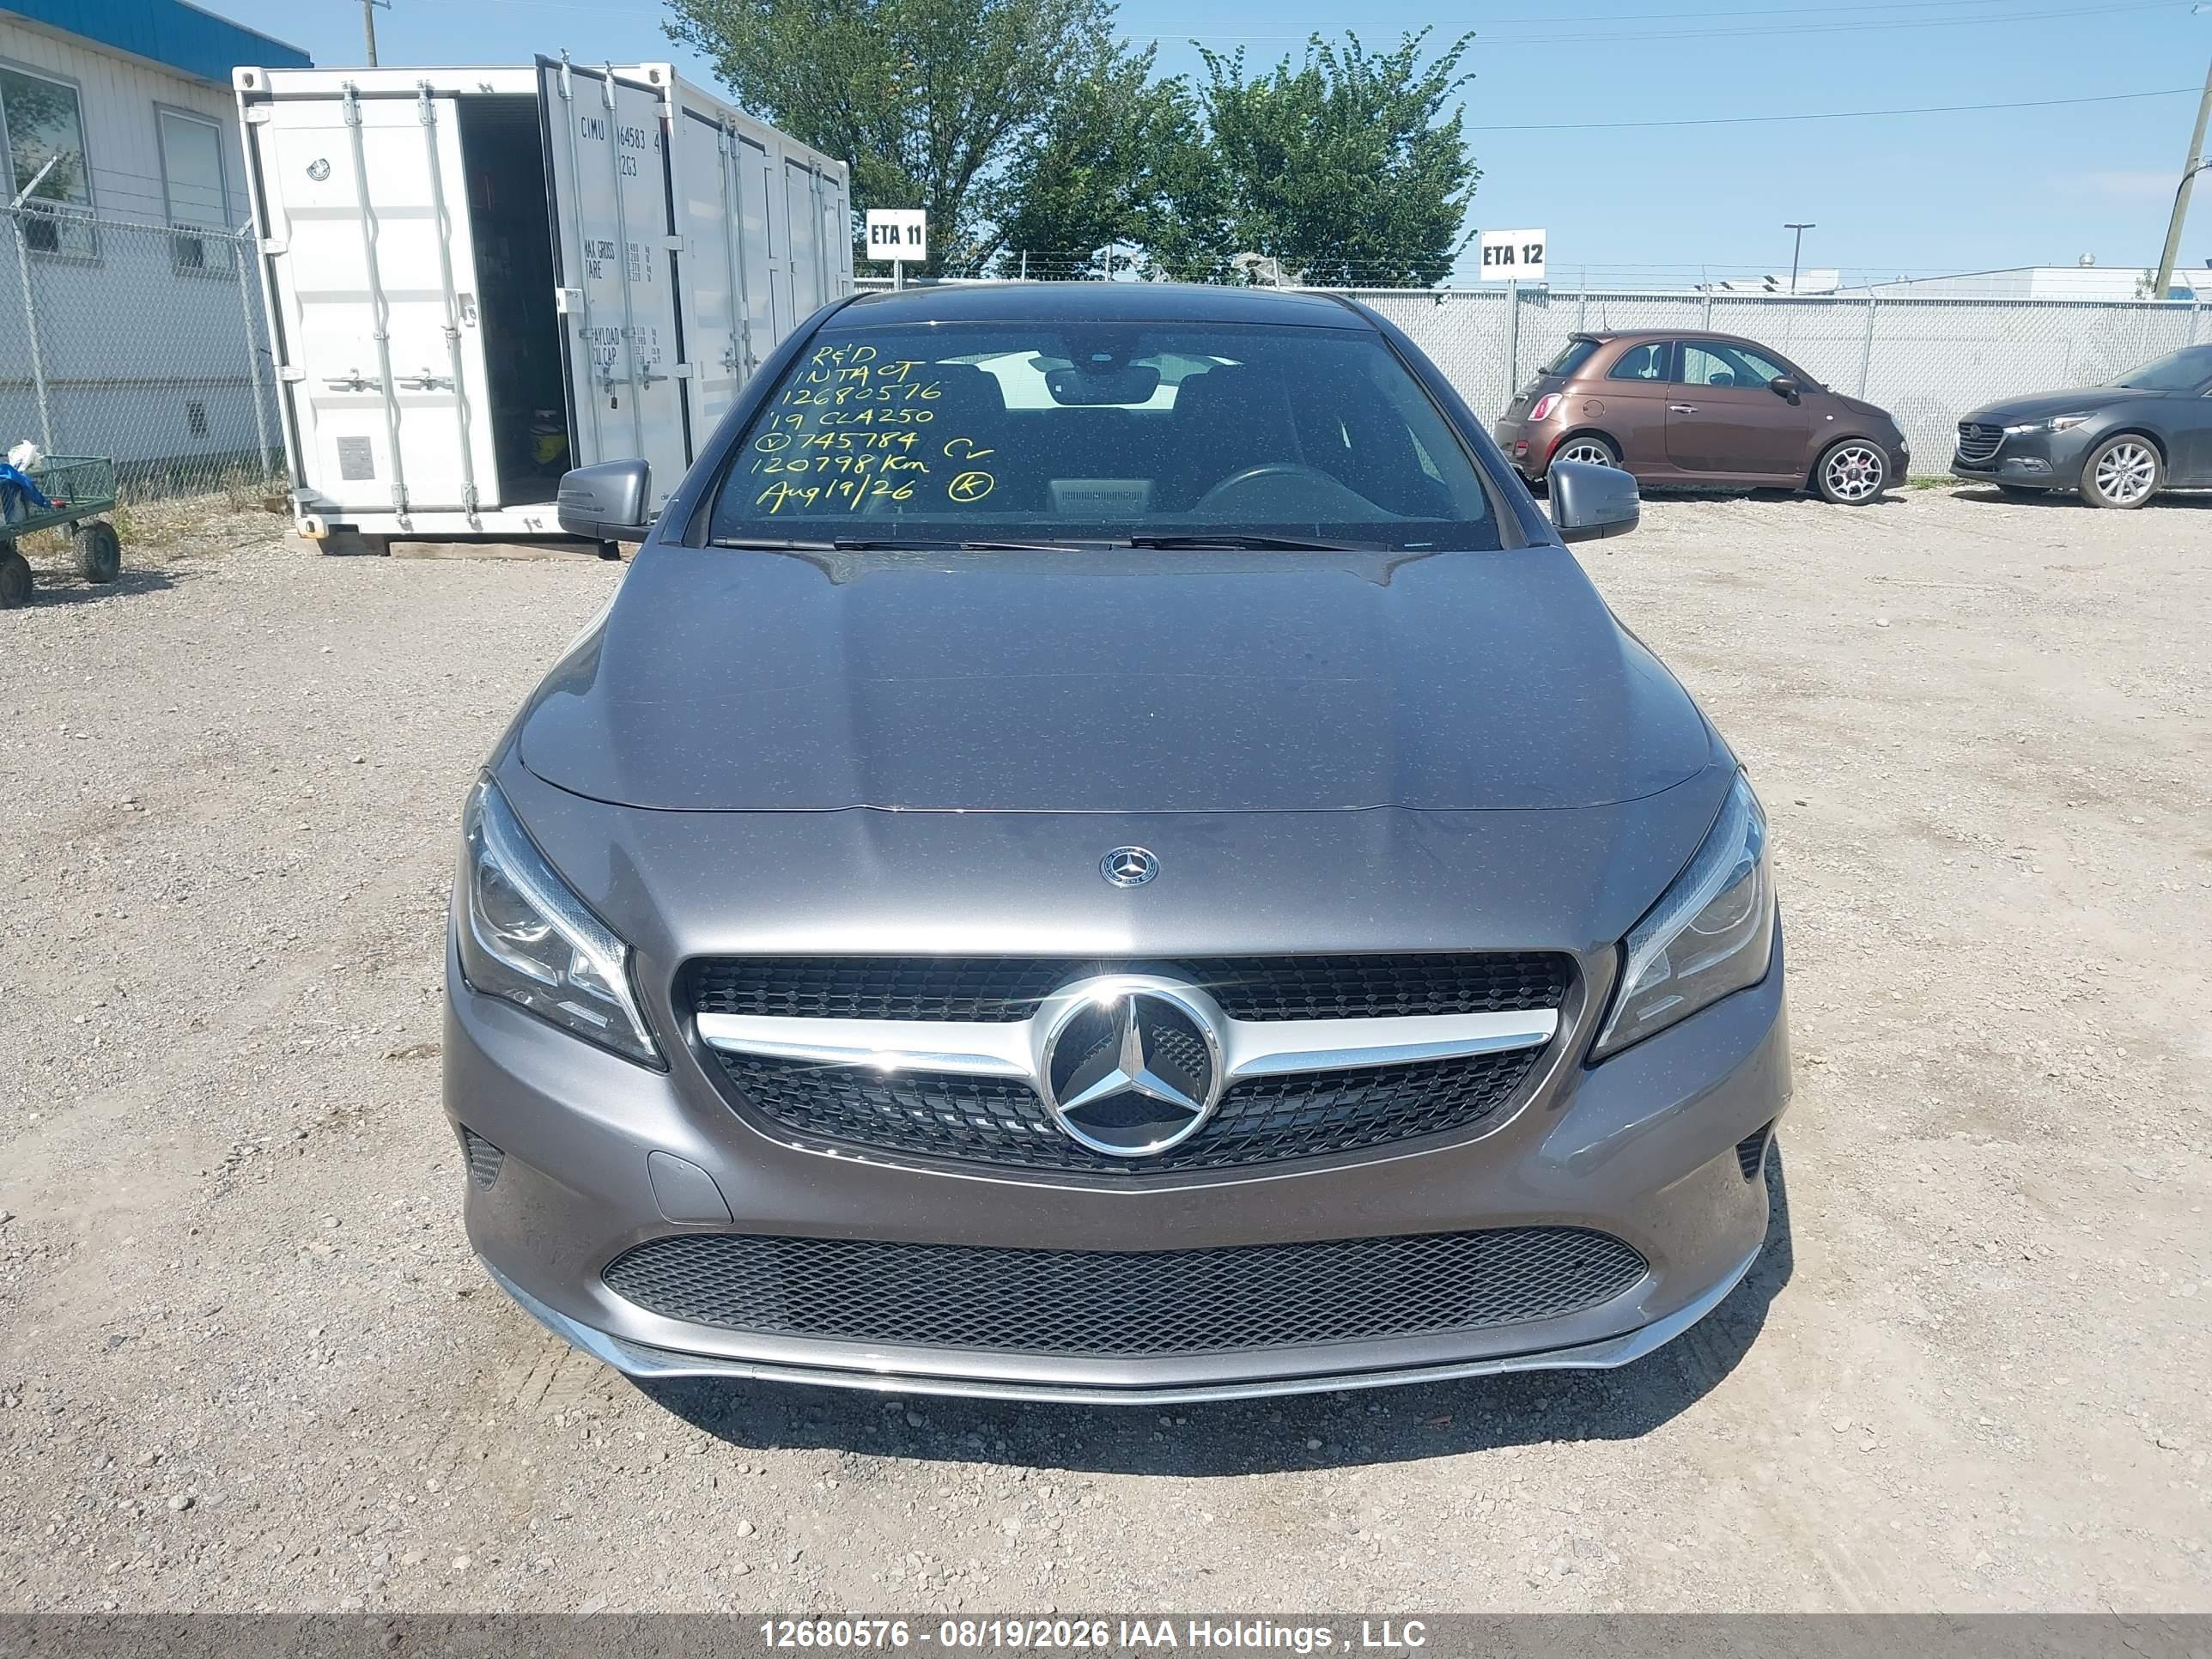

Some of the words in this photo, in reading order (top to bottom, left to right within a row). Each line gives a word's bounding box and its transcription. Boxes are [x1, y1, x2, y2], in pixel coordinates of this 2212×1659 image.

[580, 116, 605, 141] CIMU
[872, 224, 900, 245] ETA
[907, 225, 921, 245] 11
[598, 240, 615, 260] GROSS
[1484, 245, 1515, 266] ETA
[1522, 244, 1544, 264] 12
[592, 326, 620, 345] AYLOAD
[782, 381, 943, 405] 12680576
[819, 408, 934, 425] CLA250
[798, 431, 921, 453] 745784
[750, 454, 877, 474] 120798
[825, 473, 914, 511] 19/26
